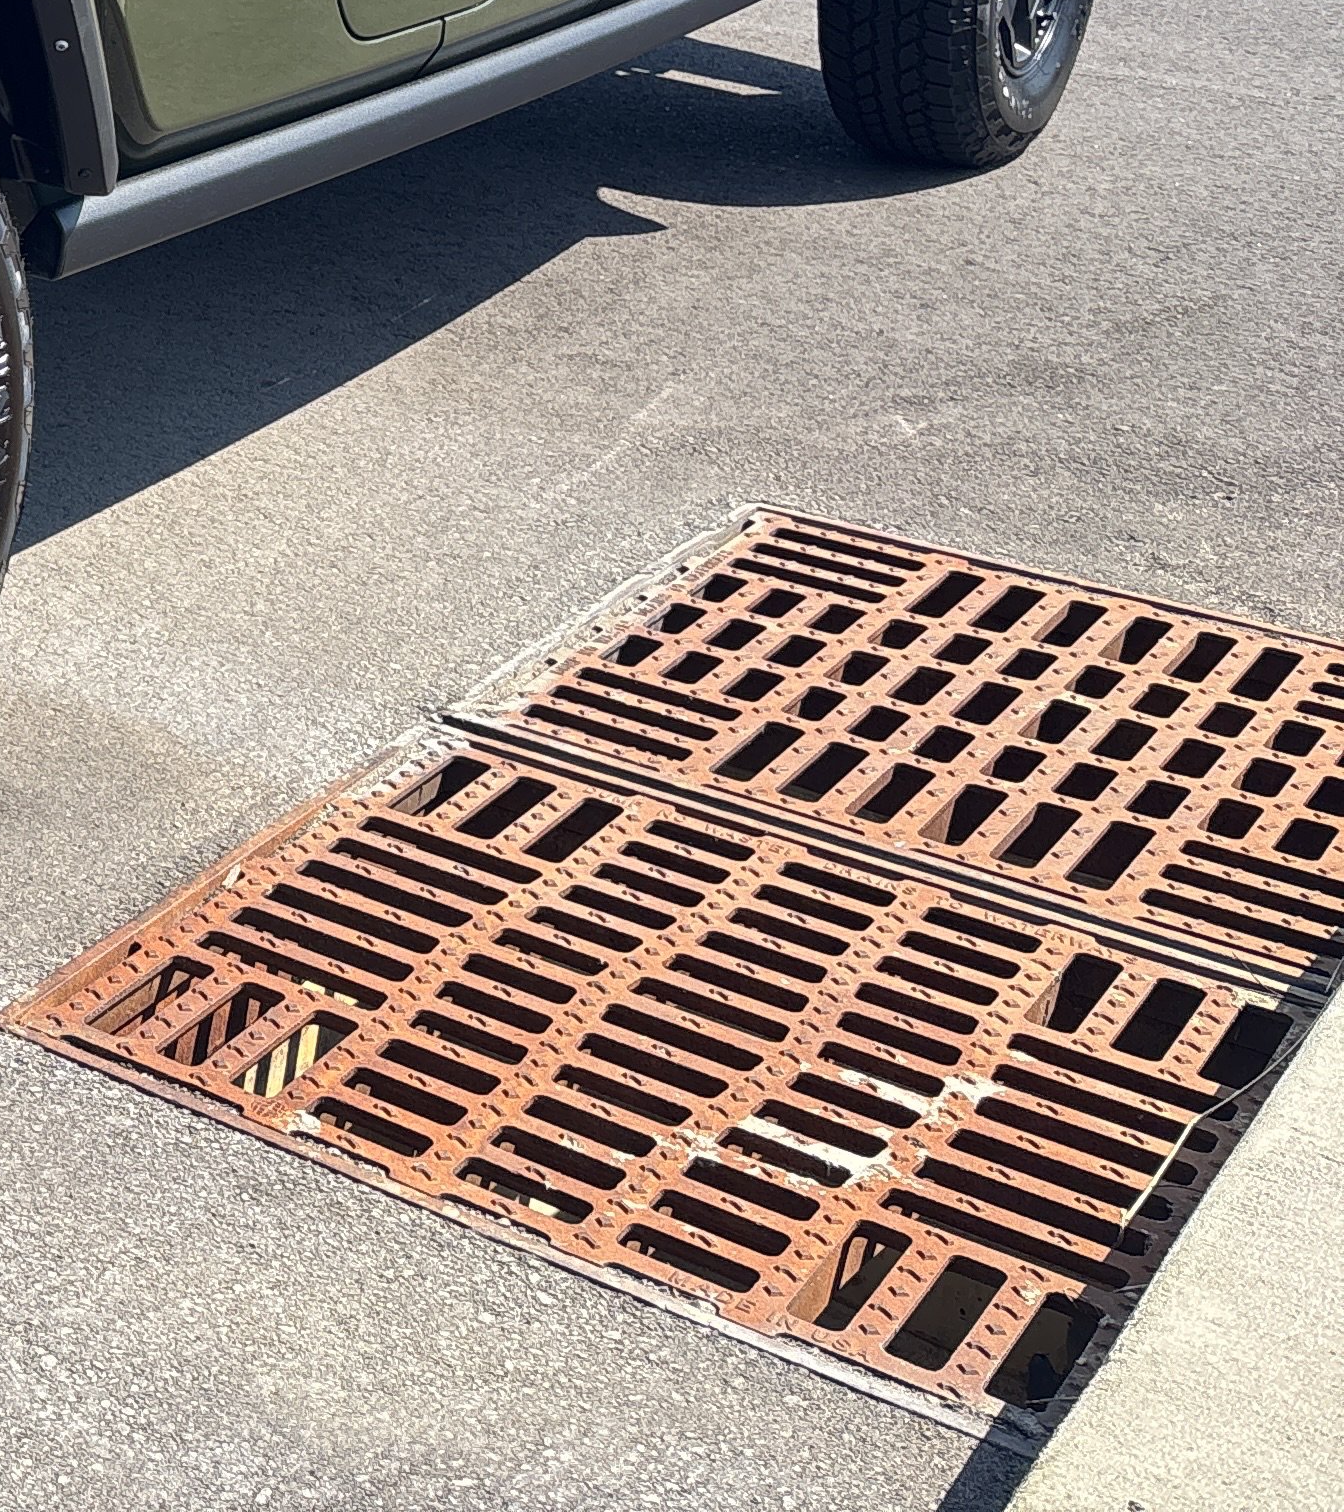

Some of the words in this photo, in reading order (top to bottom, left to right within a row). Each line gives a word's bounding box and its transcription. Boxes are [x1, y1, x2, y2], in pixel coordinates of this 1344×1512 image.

[822, 862, 917, 896] DRAINS
[933, 895, 963, 911] TO
[667, 1270, 758, 1315] MADE
[765, 1310, 800, 1332] IN
[811, 1328, 870, 1364] USA
